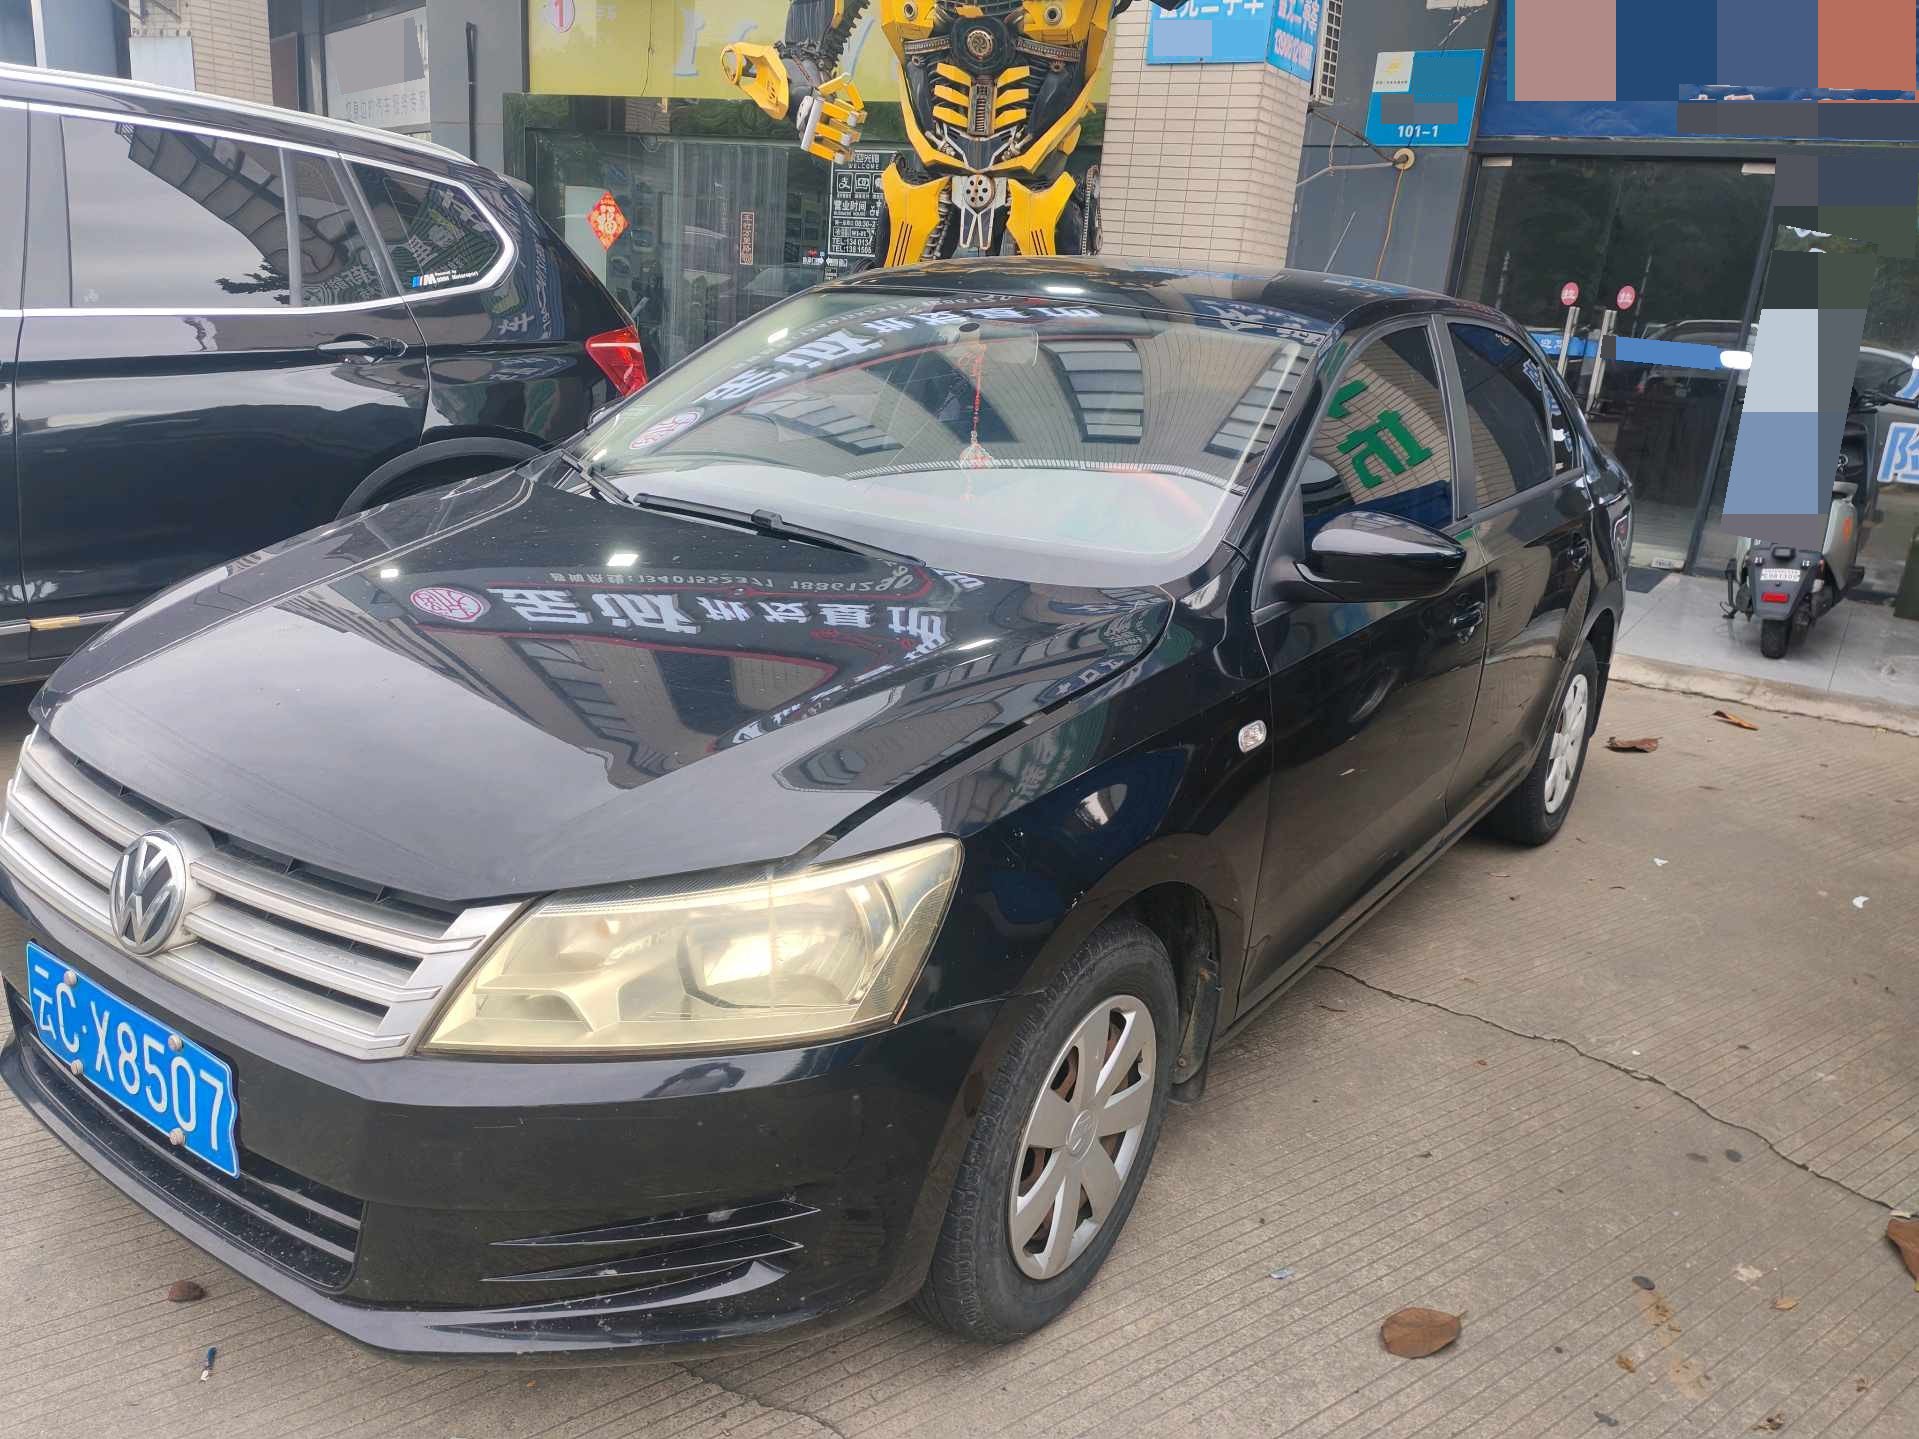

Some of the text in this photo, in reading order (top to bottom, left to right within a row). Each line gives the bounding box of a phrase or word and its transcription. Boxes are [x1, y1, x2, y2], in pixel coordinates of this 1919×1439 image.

[1398, 125, 1438, 137] 101-1
[834, 200, 866, 211] 营业时间
